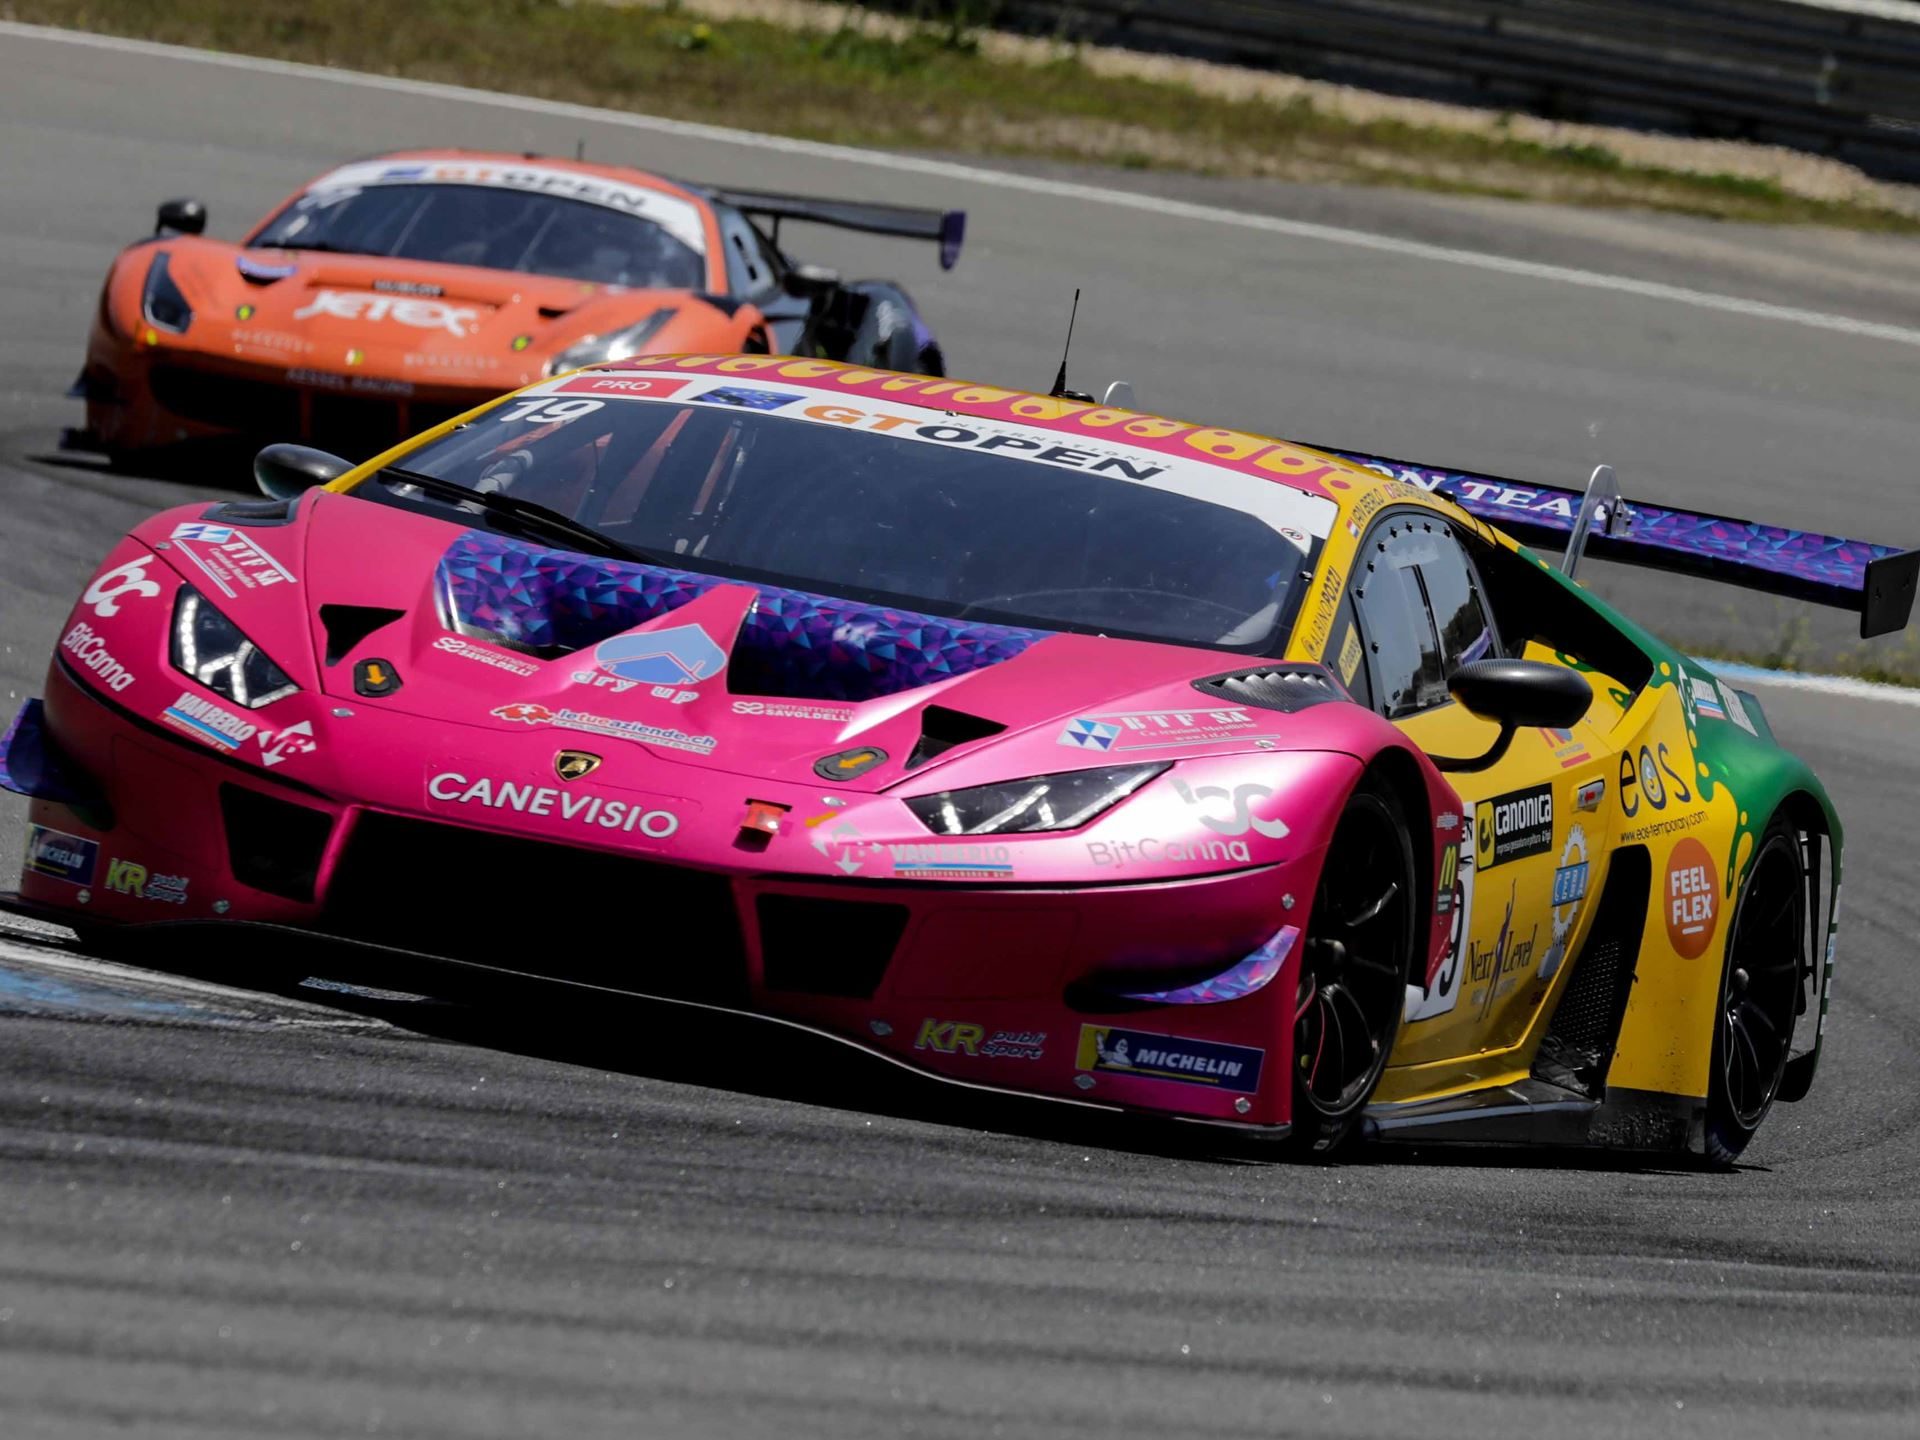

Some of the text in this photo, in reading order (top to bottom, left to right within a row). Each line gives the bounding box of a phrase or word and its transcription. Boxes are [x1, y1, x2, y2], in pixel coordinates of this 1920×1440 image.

[294, 289, 479, 337] JETEX
[591, 379, 653, 391] PRO
[500, 398, 606, 424] 19
[803, 404, 1164, 481] GT OPEN
[941, 419, 1175, 471] INTERNATIONAL
[62, 622, 136, 692] BitCanna
[570, 669, 699, 704] dry up
[558, 708, 718, 749] letueaziende.ch
[1209, 710, 1254, 725] SA
[1619, 741, 1691, 818] eos
[427, 773, 679, 839] CANEVISIO
[1495, 793, 1553, 836] canonica
[1620, 811, 1709, 843] www.eos-temporary.com
[1087, 837, 1251, 869] BitCanna
[105, 857, 148, 898] KR
[1671, 865, 1711, 897] FEEL
[1672, 893, 1713, 926] FLEX
[914, 1017, 985, 1056] KR
[981, 1041, 1043, 1060] sport
[990, 1031, 1047, 1046] publi
[1135, 1048, 1243, 1077] MICHELIN
